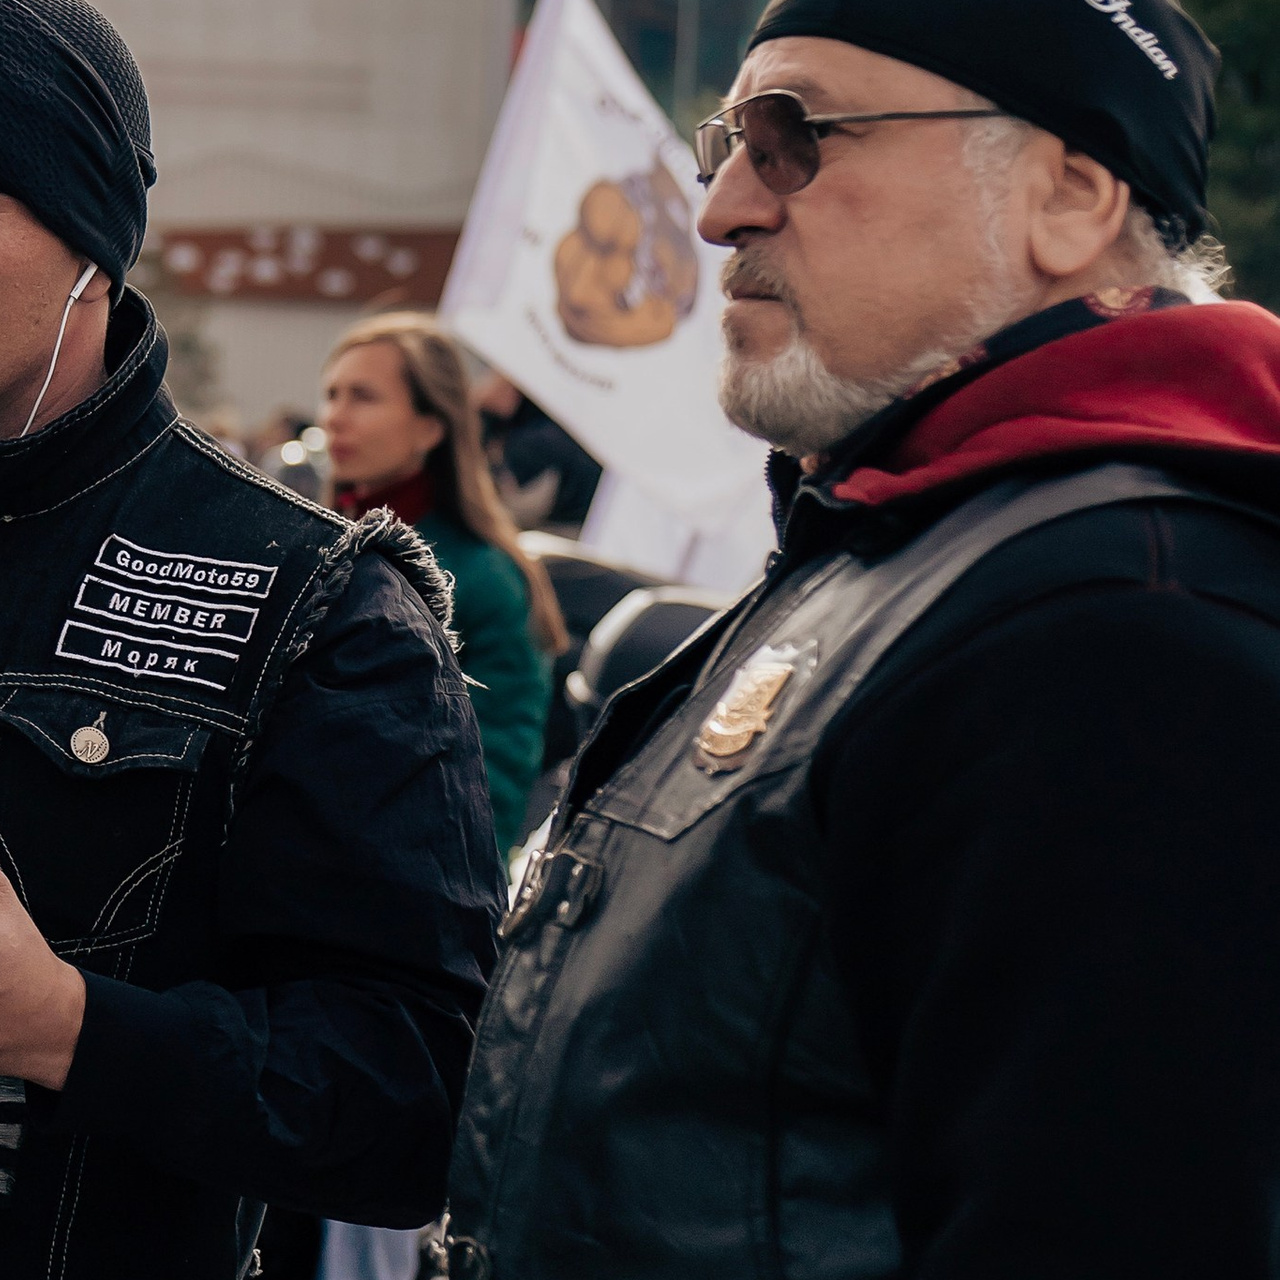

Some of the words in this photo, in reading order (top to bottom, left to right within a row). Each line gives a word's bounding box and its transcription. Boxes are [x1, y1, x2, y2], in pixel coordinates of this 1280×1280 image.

[116, 549, 260, 589] GoodMoto59
[109, 592, 226, 629] MEMBER
[101, 639, 199, 673] Моряк
